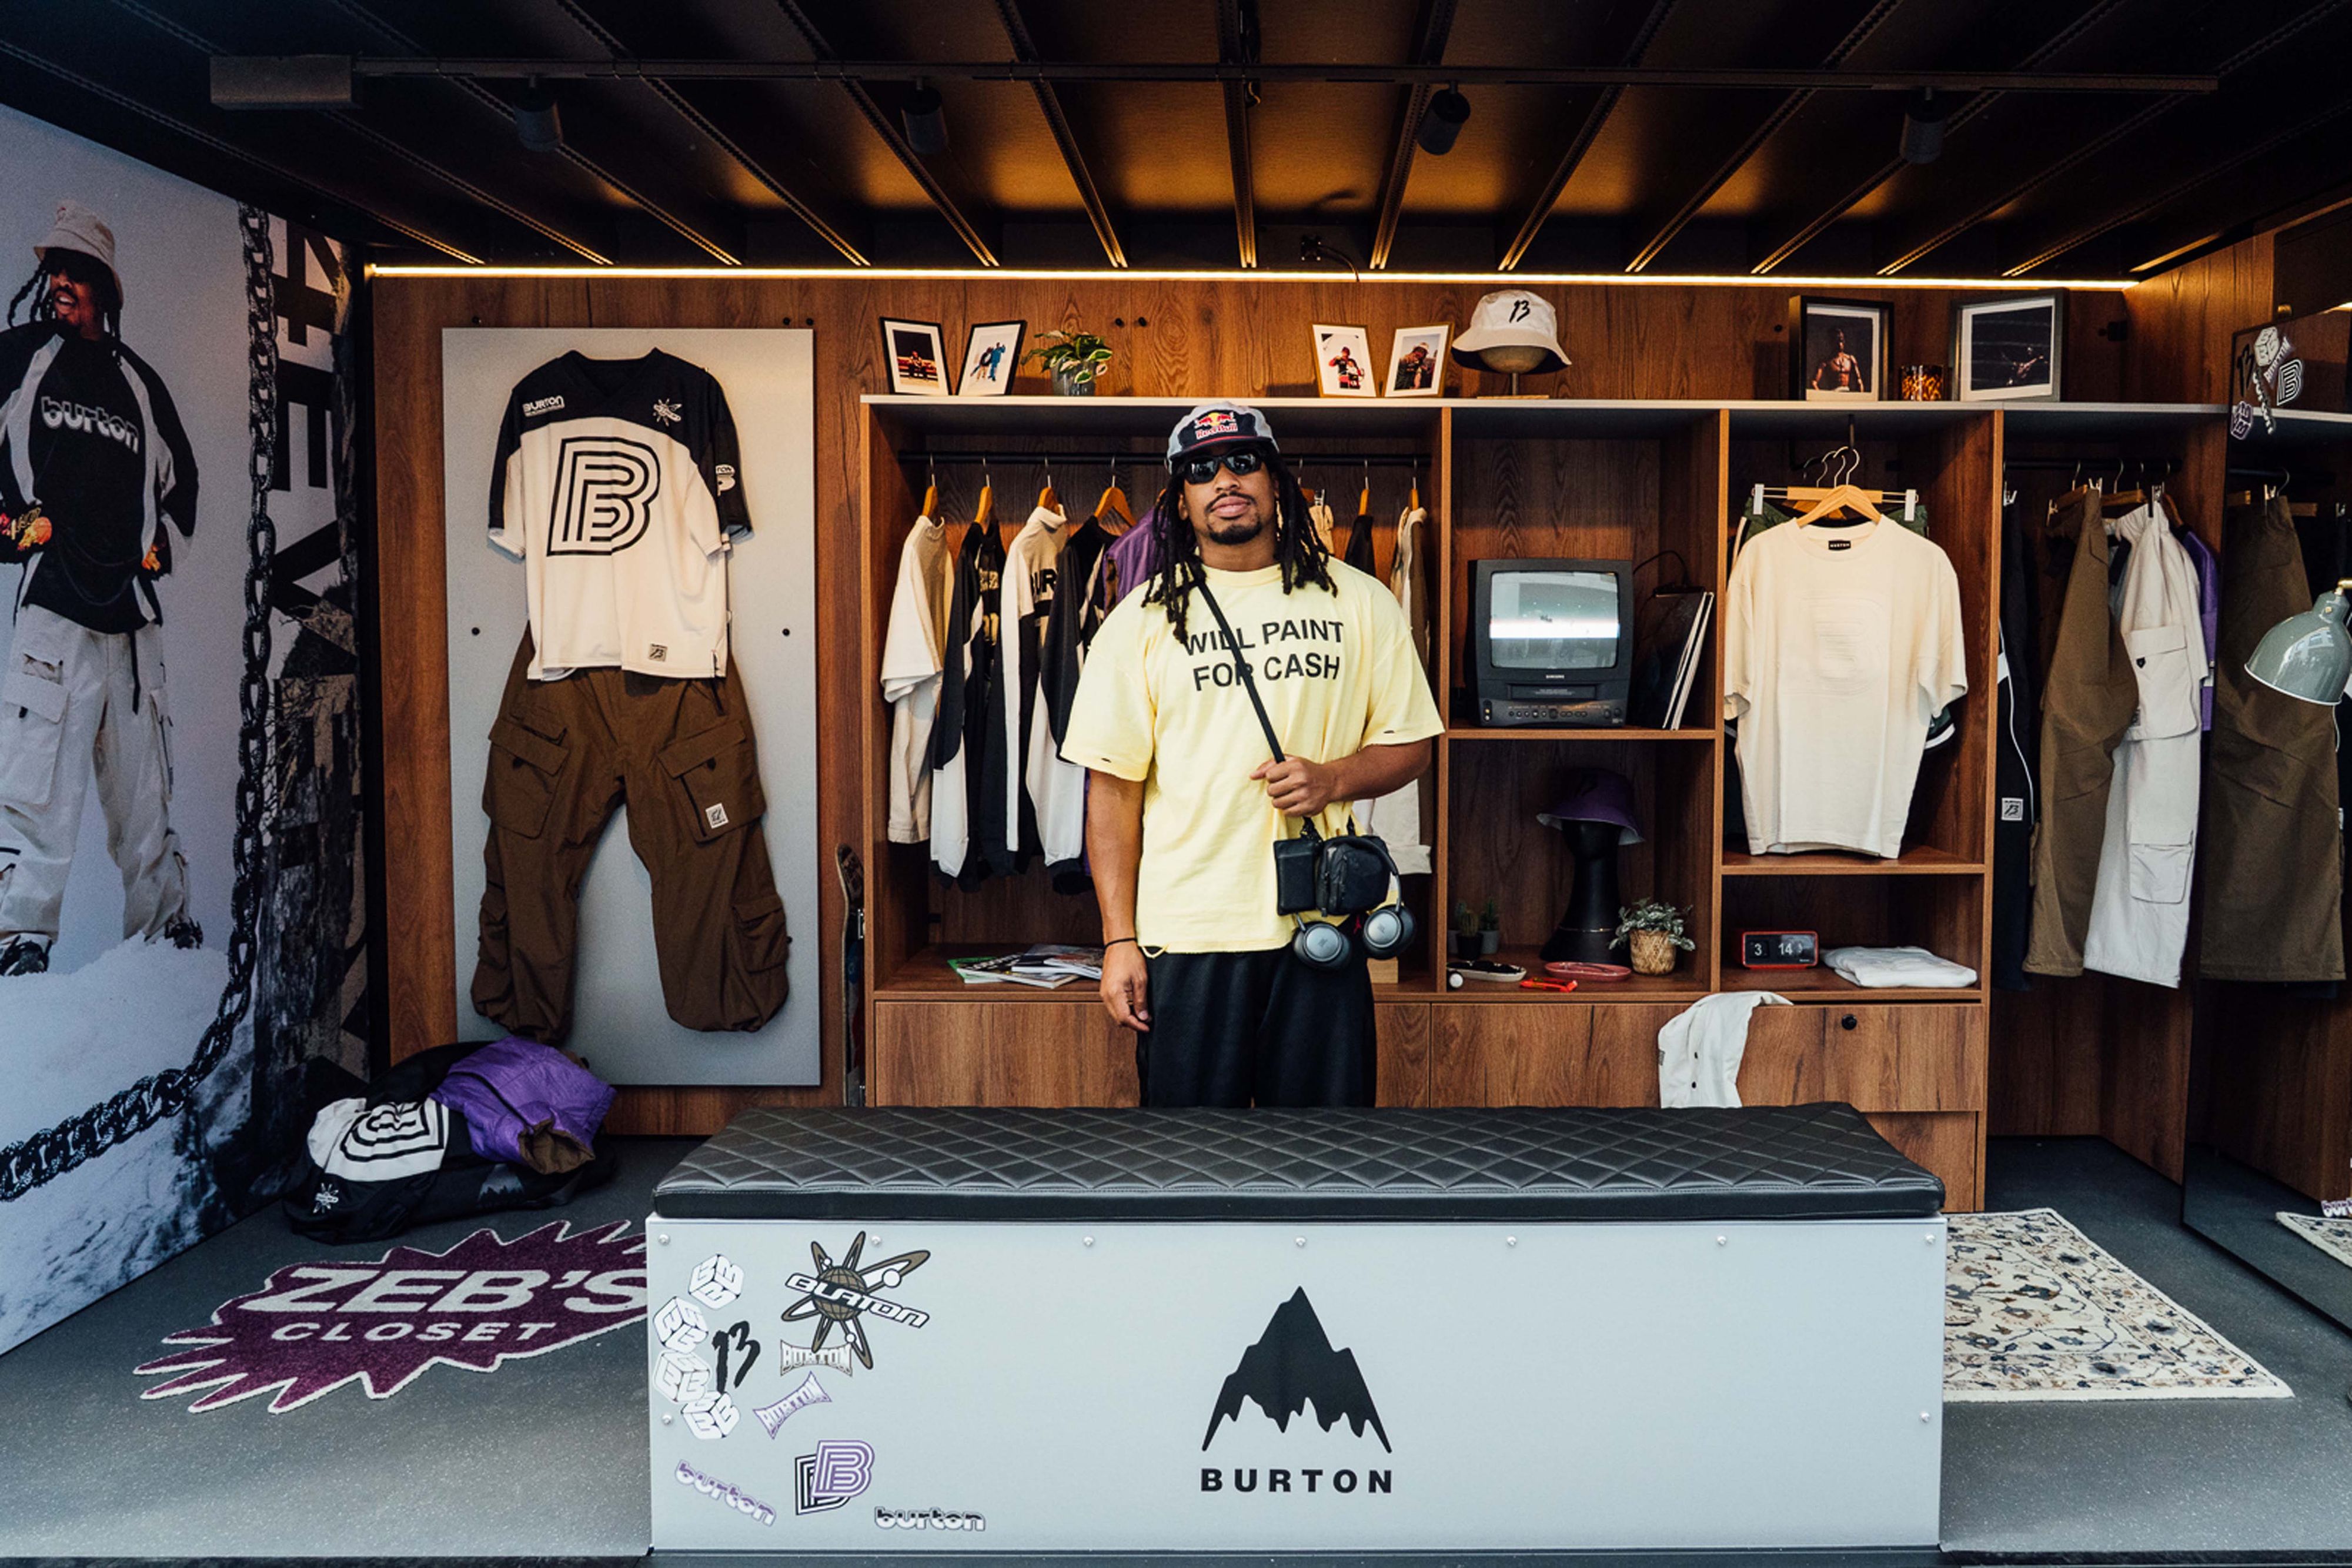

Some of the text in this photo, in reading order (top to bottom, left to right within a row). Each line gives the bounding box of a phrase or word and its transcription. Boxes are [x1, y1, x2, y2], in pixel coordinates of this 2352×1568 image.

[1509, 299, 1530, 323] 13
[41, 397, 139, 454] burton
[1183, 619, 1344, 656] WILL PAINT
[1193, 653, 1340, 691] FOR CASH
[1754, 942, 1793, 957] 3 14
[238, 1268, 647, 1313] ZEB'S
[784, 1273, 930, 1329] BURTON
[271, 1322, 556, 1342] CLOSET
[711, 1320, 761, 1395] 13
[781, 1340, 853, 1376] BURTON
[676, 1459, 776, 1527] burton
[1201, 1468, 1392, 1493] BURTON
[875, 1507, 985, 1532] burton
